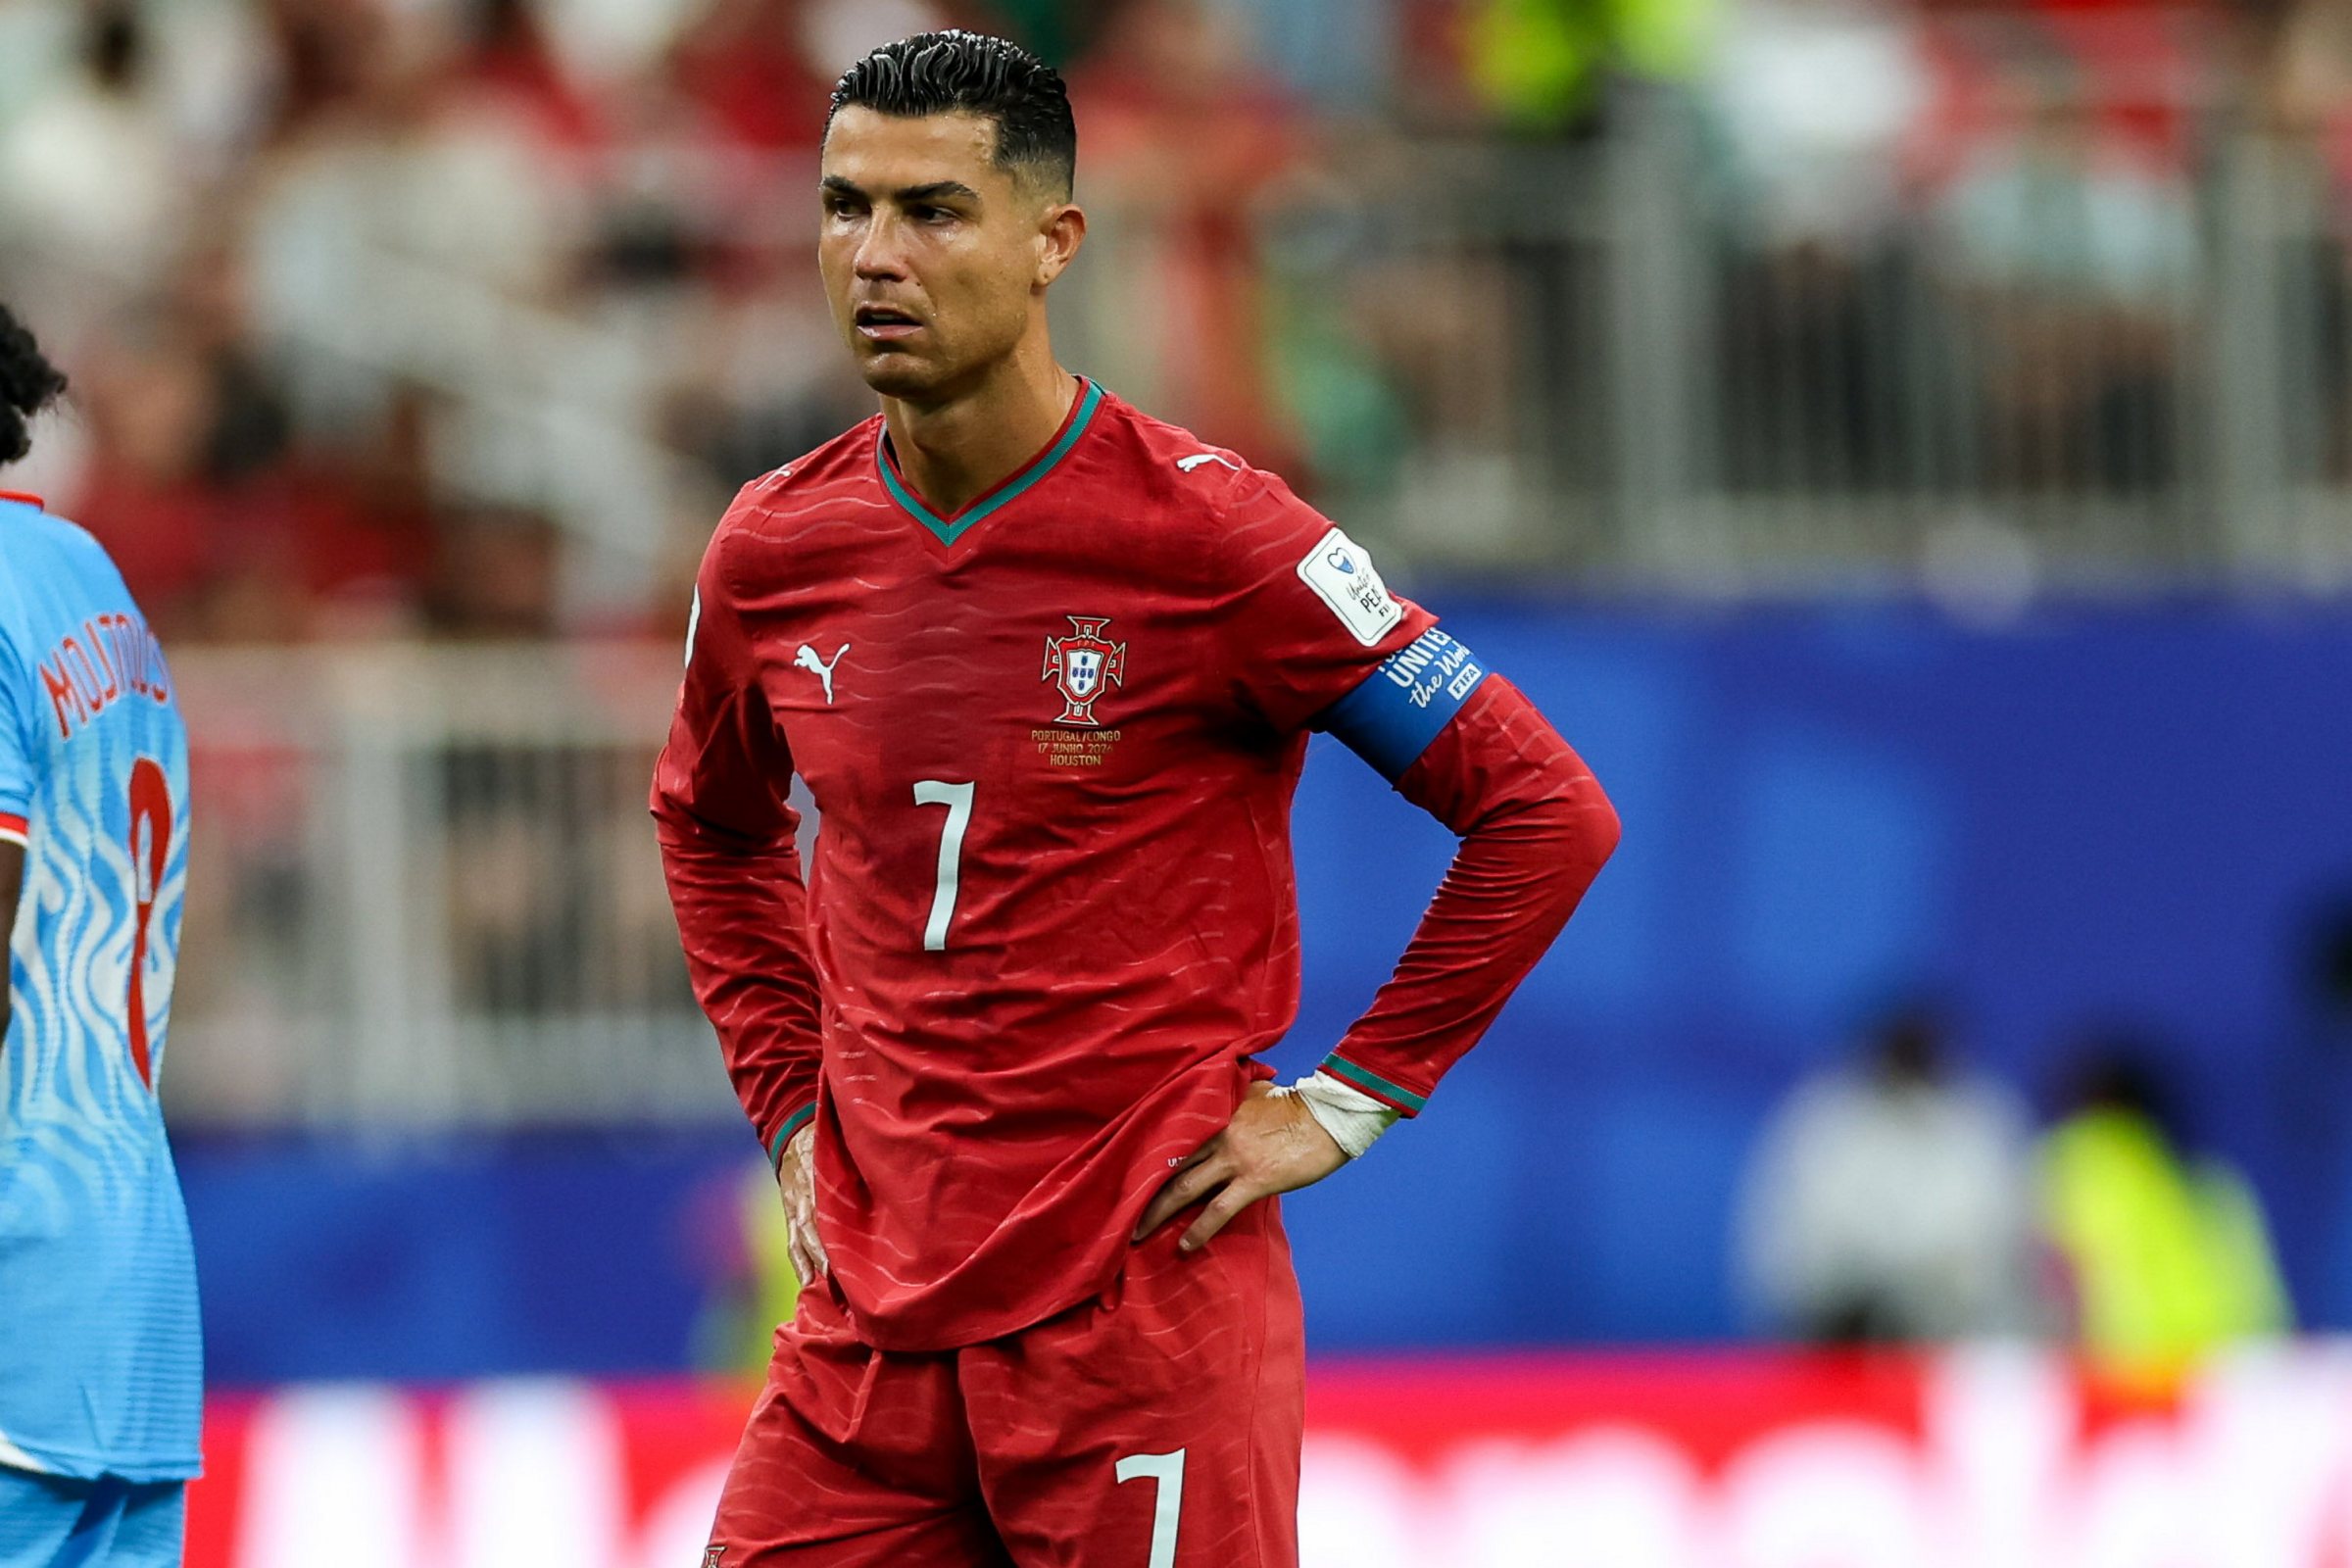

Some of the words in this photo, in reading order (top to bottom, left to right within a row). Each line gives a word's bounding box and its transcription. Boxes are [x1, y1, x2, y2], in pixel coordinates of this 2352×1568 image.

[1409, 673, 1443, 708] the
[1450, 667, 1481, 695] FIFA
[1032, 730, 1121, 743] PORTUGAL/CONGO
[1038, 744, 1048, 754] 17
[1052, 744, 1084, 754] JUNHO
[1050, 755, 1102, 766] HOUSTON
[913, 780, 975, 951] 7
[1115, 1447, 1186, 1568] 7
